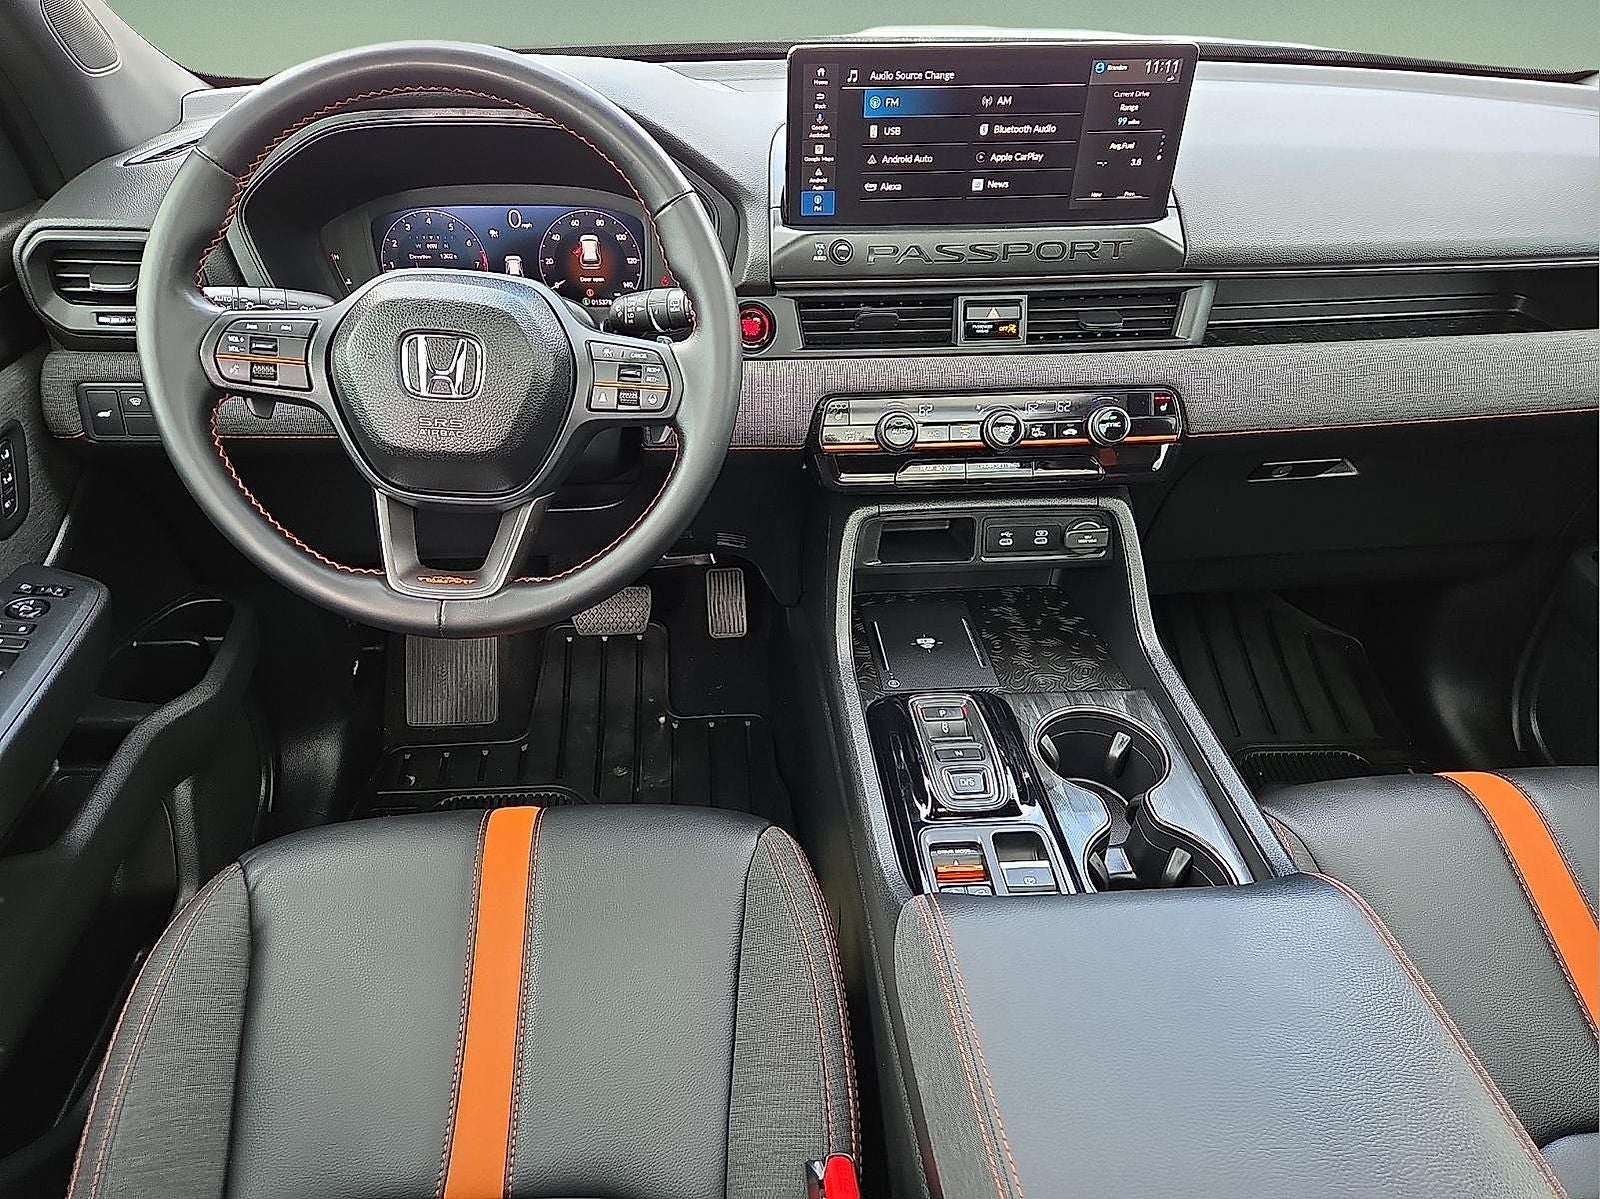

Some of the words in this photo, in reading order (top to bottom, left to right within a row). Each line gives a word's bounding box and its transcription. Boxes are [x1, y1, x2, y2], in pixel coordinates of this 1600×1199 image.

[1145, 60, 1179, 74] 11:11
[870, 71, 894, 80] Audio
[895, 71, 923, 80] Source
[925, 71, 955, 81] Change
[885, 97, 900, 108] FM
[997, 96, 1012, 106] AM
[1120, 103, 1139, 112] Range
[1118, 117, 1128, 125] 99
[884, 126, 901, 136] USB
[993, 124, 1032, 134] Bluetooth
[1033, 124, 1057, 134] Audio
[882, 154, 912, 164] Android
[913, 154, 933, 164] Auto
[990, 152, 1013, 164] Apple
[1014, 152, 1043, 163] CarPlay
[880, 182, 902, 191] Alexa
[987, 180, 1010, 189] News
[426, 217, 432, 225] 4
[507, 209, 522, 228] 0
[595, 219, 605, 227] 80
[448, 223, 455, 231] 5
[391, 239, 398, 248] 2
[466, 239, 472, 247] 6
[867, 240, 1133, 264] PASSPORT
[474, 261, 481, 269] 7
[918, 405, 934, 416] 62
[1057, 401, 1072, 412] 62
[419, 417, 464, 428] SRS
[939, 709, 946, 717] P
